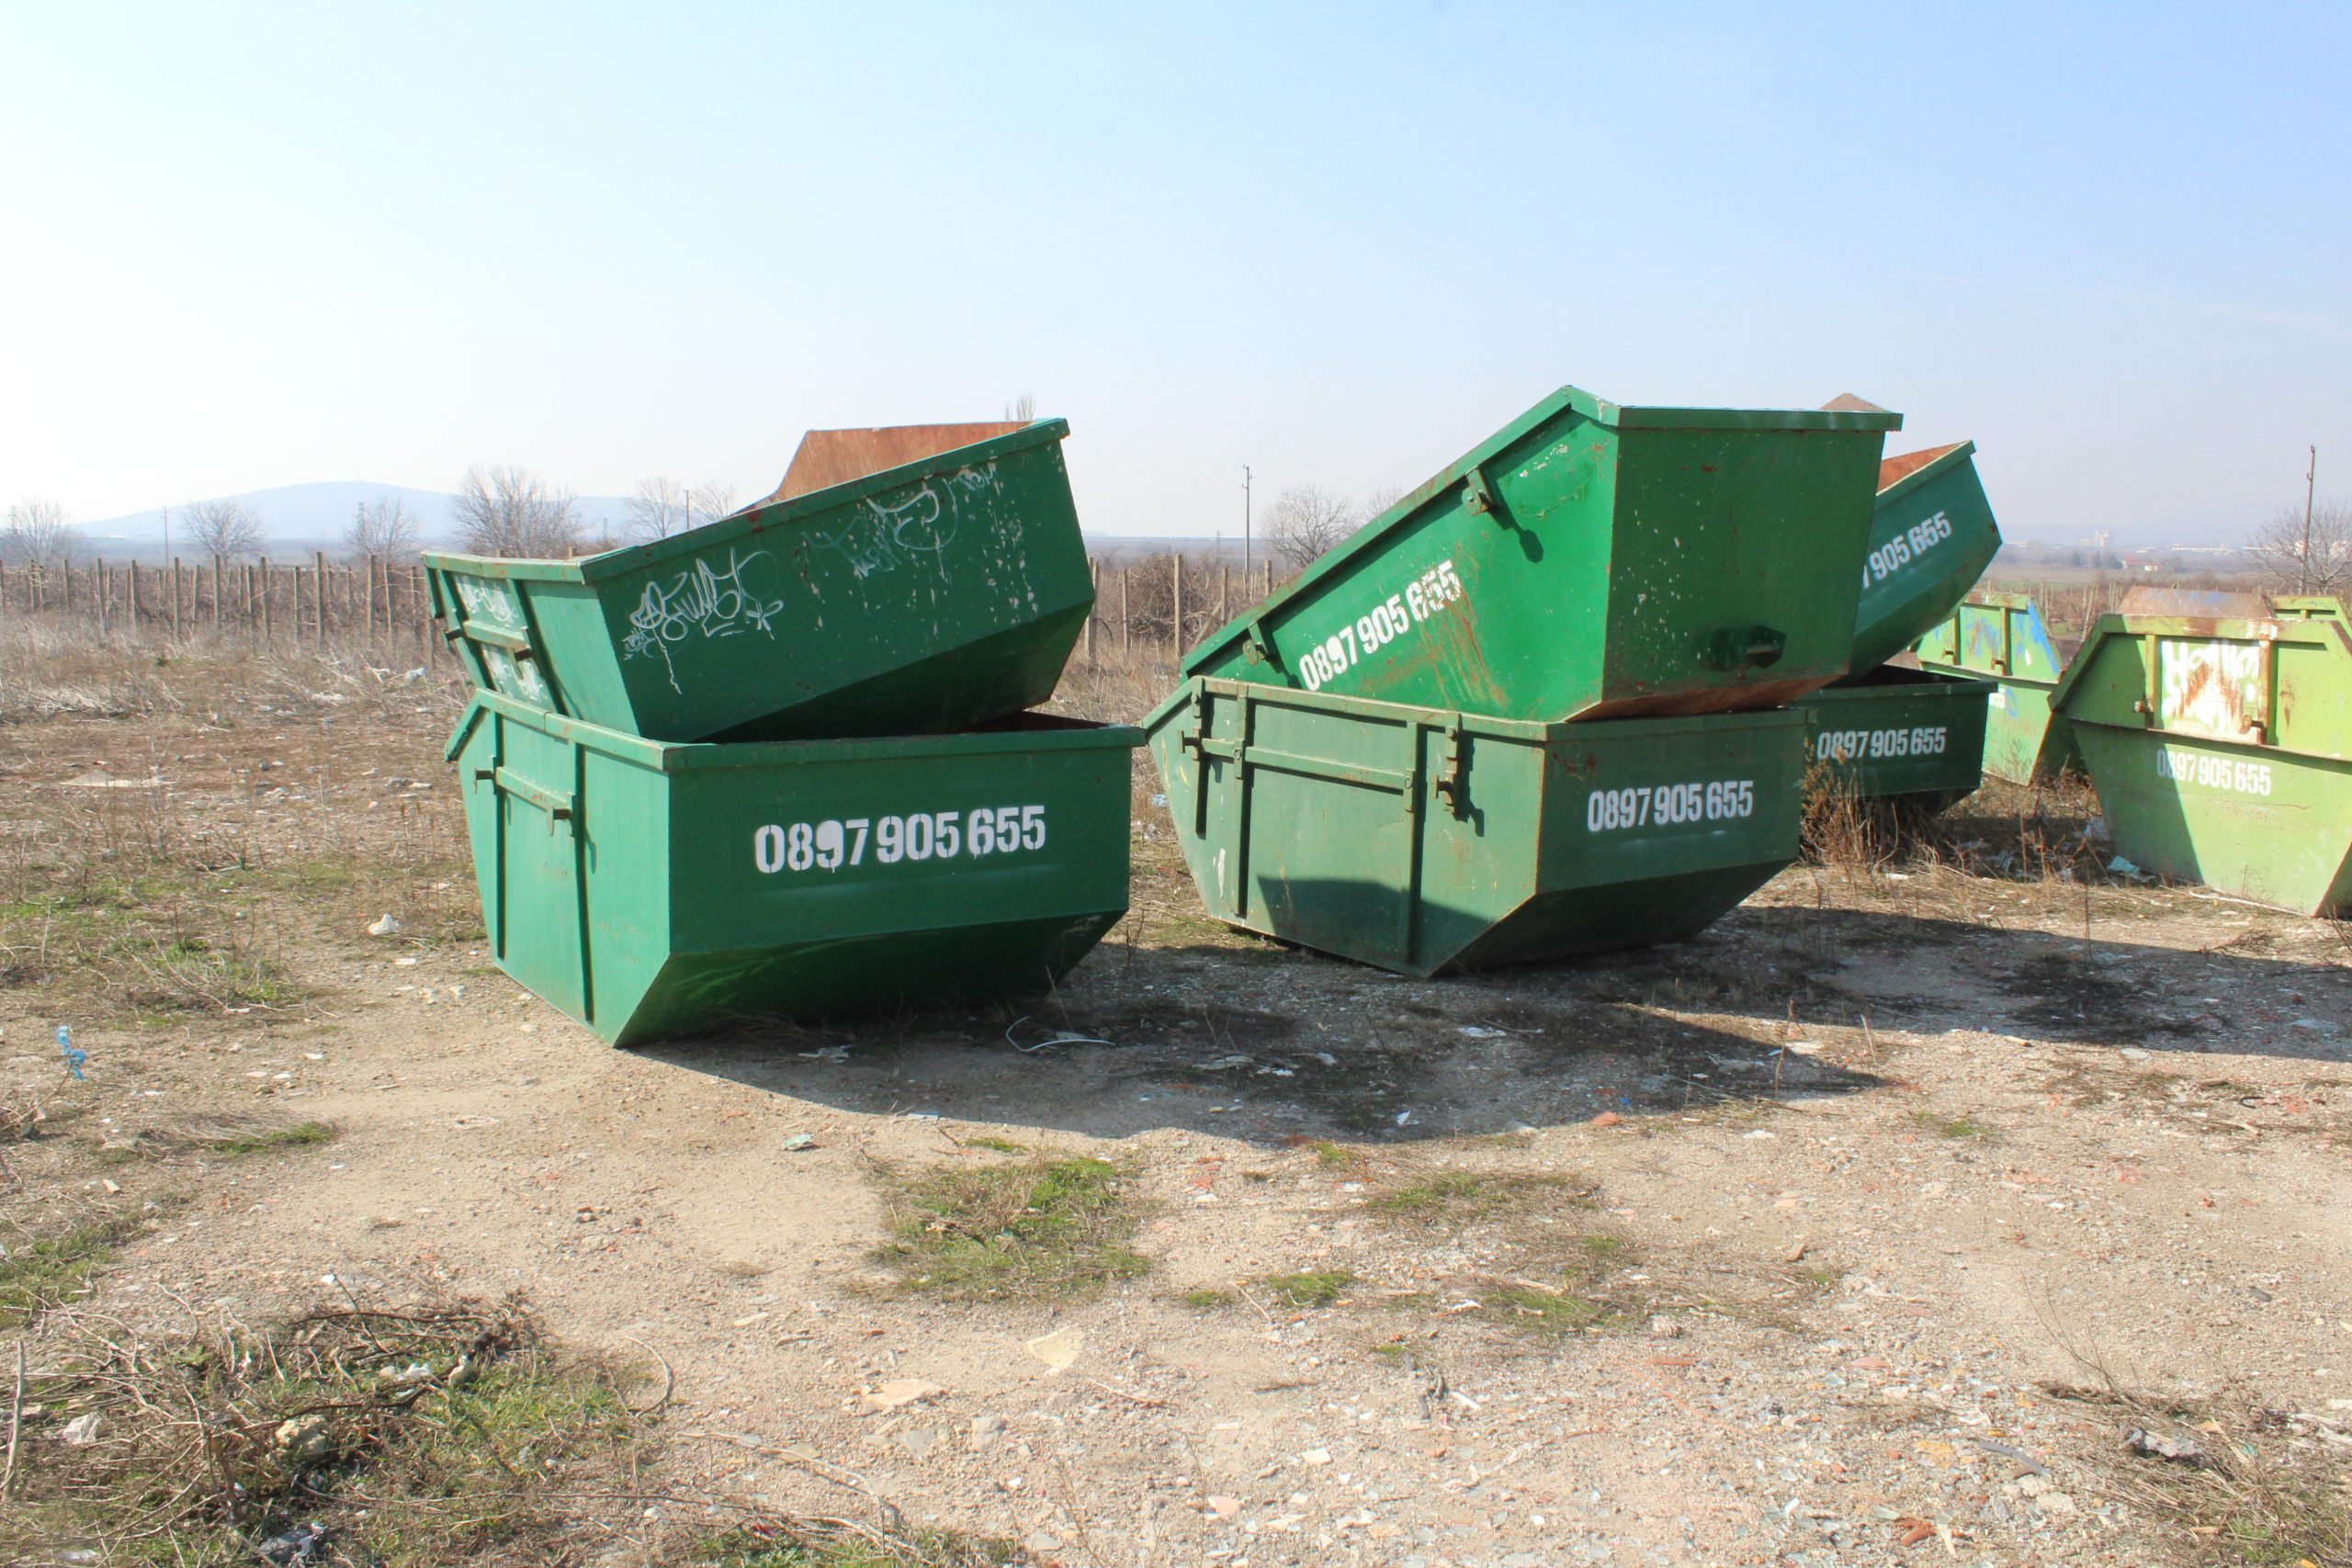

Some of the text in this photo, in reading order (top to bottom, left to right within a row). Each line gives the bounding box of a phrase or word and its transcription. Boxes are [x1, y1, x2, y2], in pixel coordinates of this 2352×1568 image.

[1869, 536, 1911, 581] 905
[1907, 511, 1952, 556] 655
[1299, 559, 1462, 692] 0897 905 655
[1816, 727, 1948, 760] 0897 905 655
[2156, 749, 2273, 797] 0897 905 655
[1588, 780, 1755, 833] 0897 905 655
[754, 805, 1046, 874] 0897 905 655
